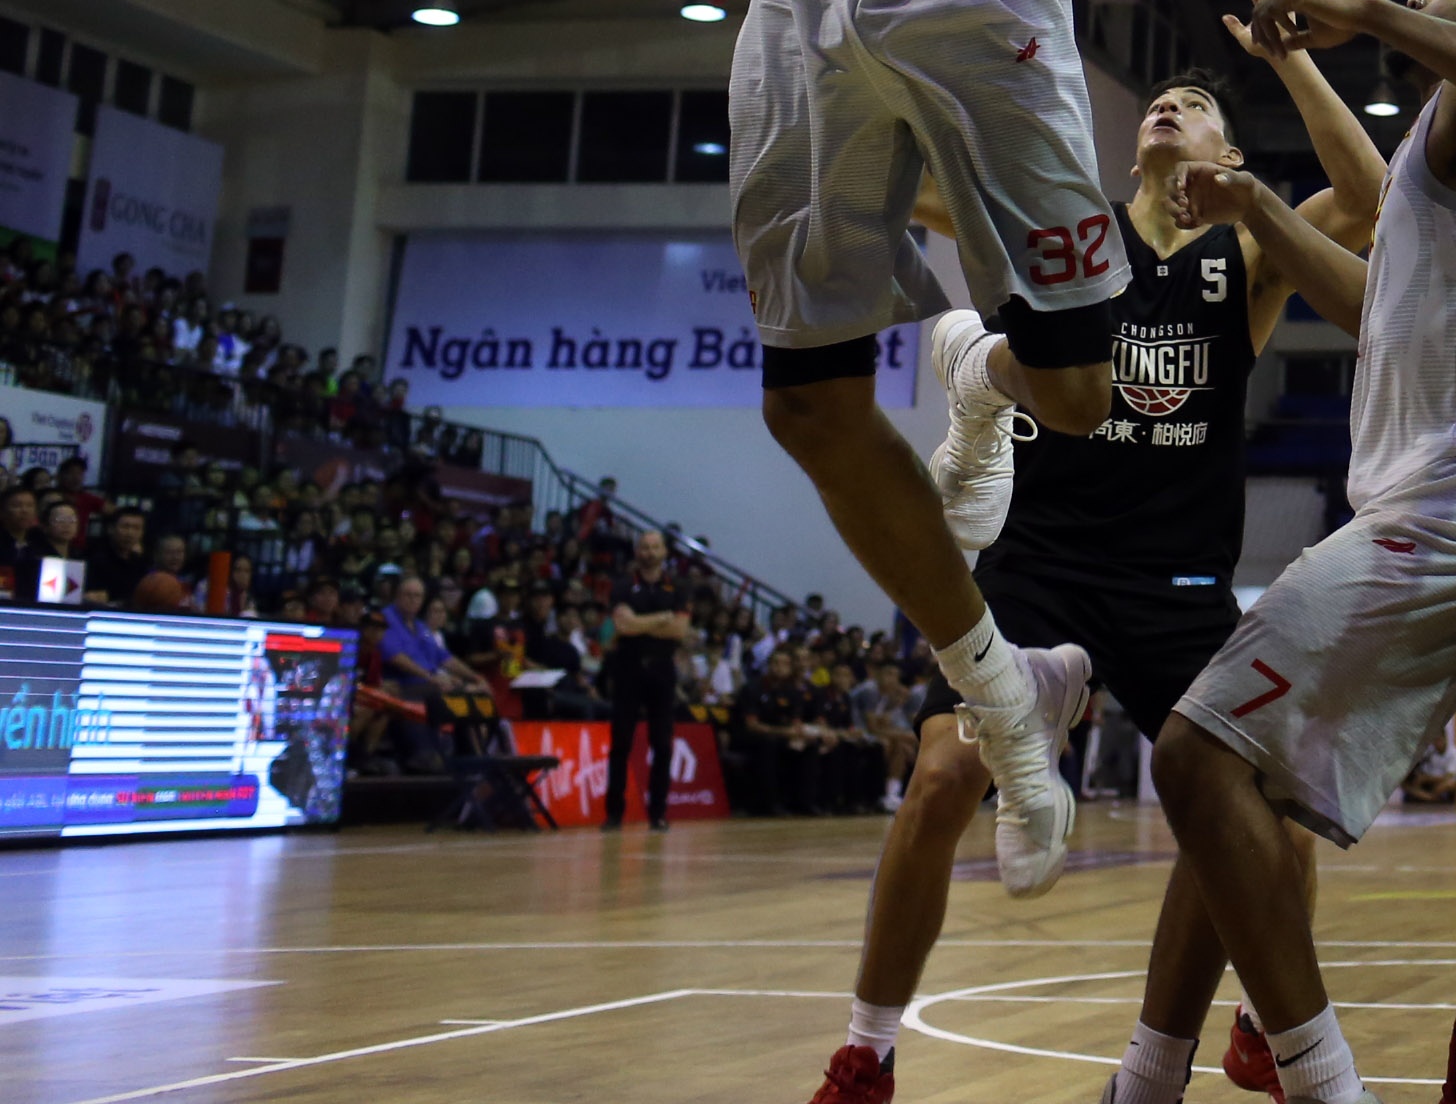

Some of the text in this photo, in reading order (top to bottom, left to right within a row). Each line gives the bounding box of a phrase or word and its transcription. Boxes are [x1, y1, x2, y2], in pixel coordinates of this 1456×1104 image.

[1027, 213, 1111, 286] 32
[1200, 258, 1228, 302] 5
[402, 326, 763, 381] Ngân hàng Bả
[1121, 322, 1194, 339] CHONGSON
[1231, 658, 1292, 718] 7
